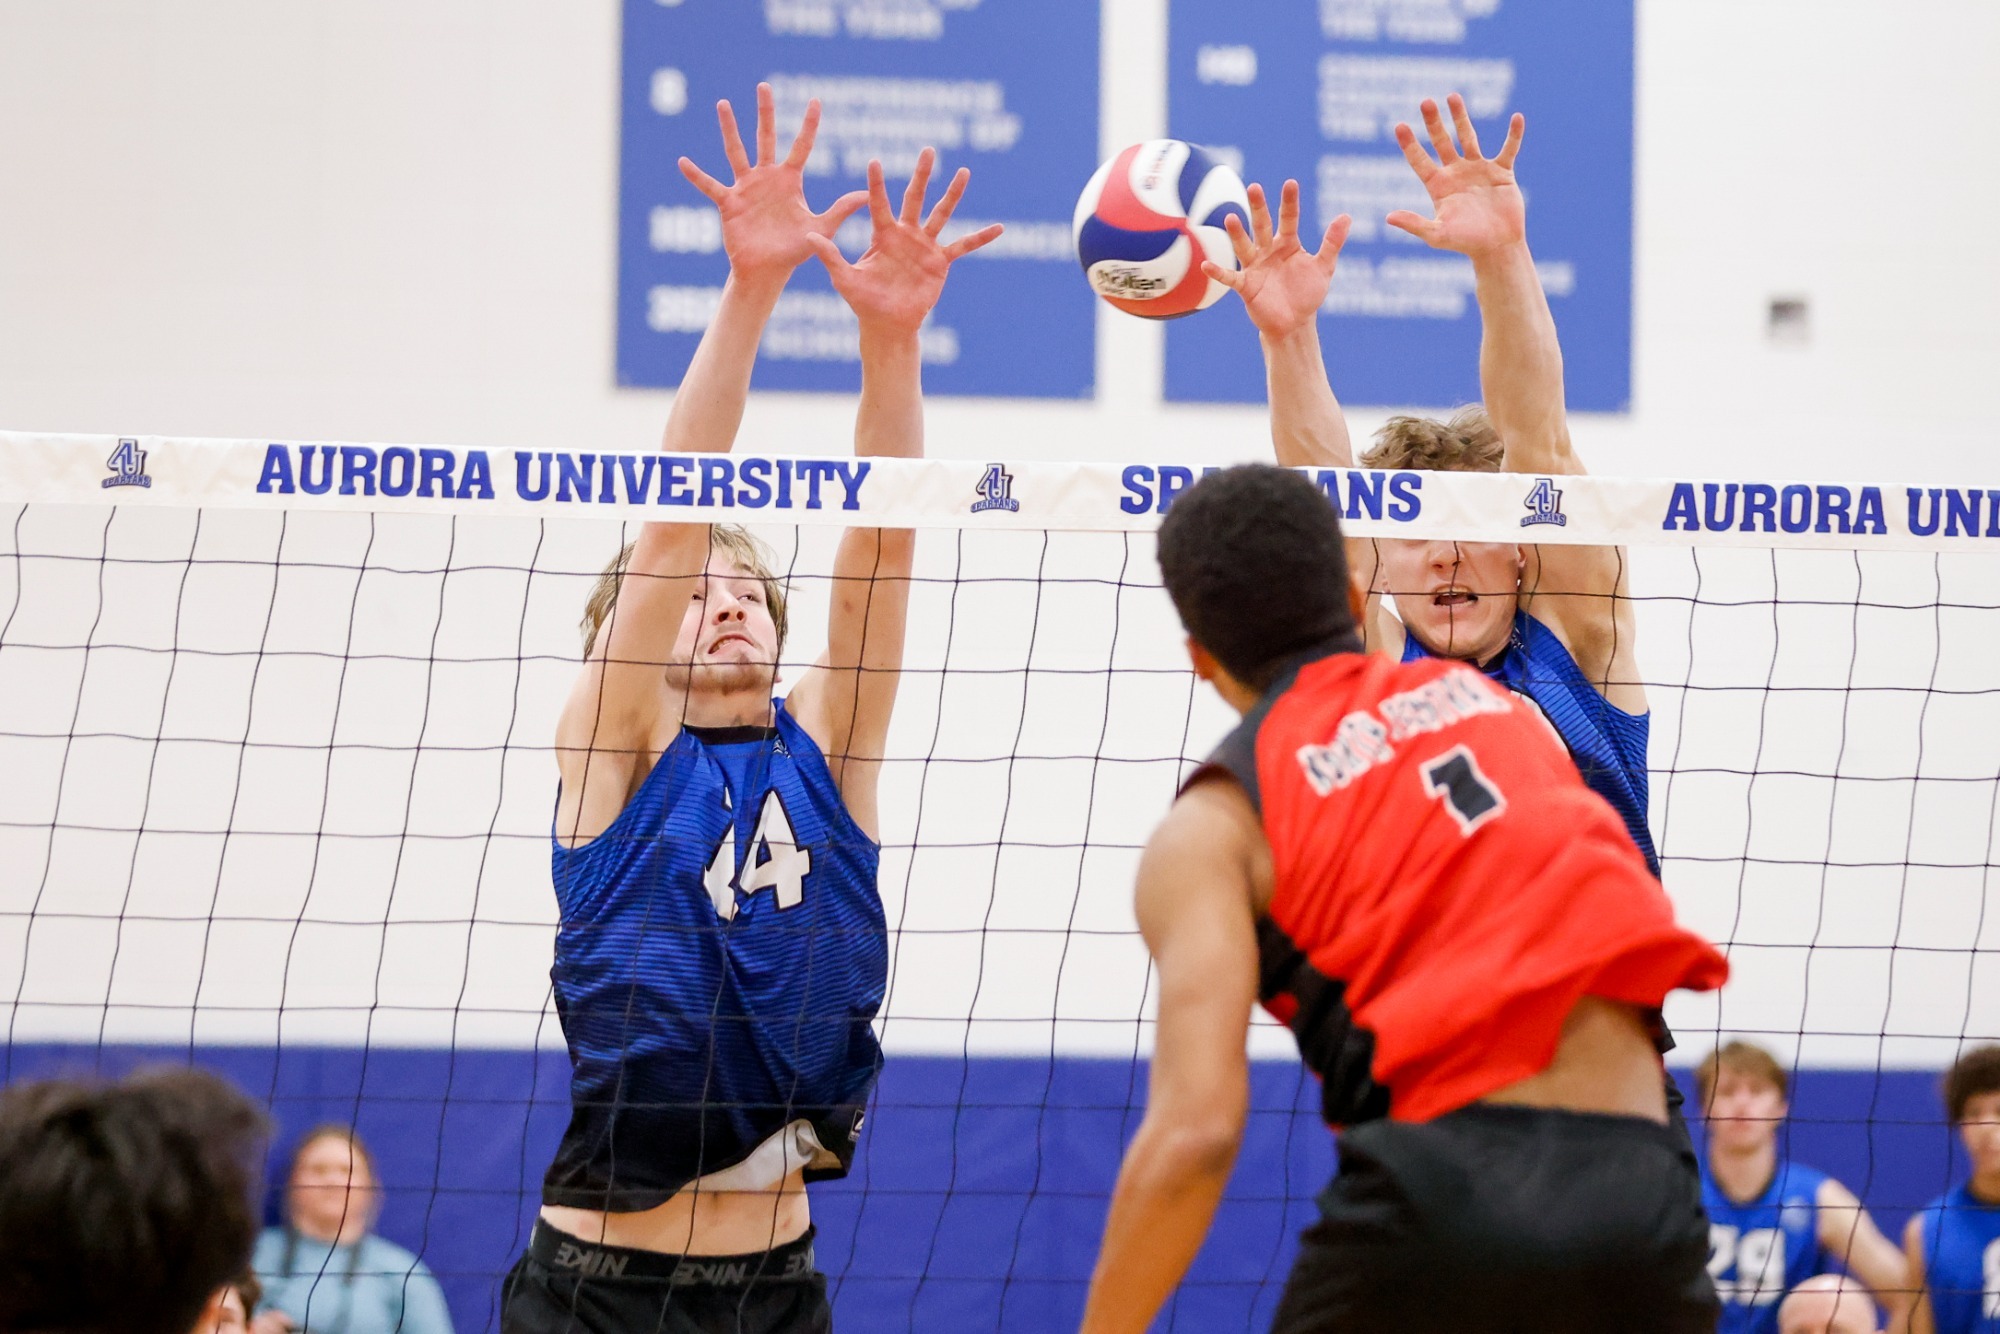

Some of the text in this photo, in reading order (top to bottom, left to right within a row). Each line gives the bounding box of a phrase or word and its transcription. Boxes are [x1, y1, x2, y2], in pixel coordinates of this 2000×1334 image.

[256, 443, 871, 511] AURORA UNIVERSITY
[1120, 465, 1422, 522] SPANS
[1662, 482, 1888, 535] AURORA
[1418, 743, 1508, 838] 1
[703, 785, 811, 922] 14
